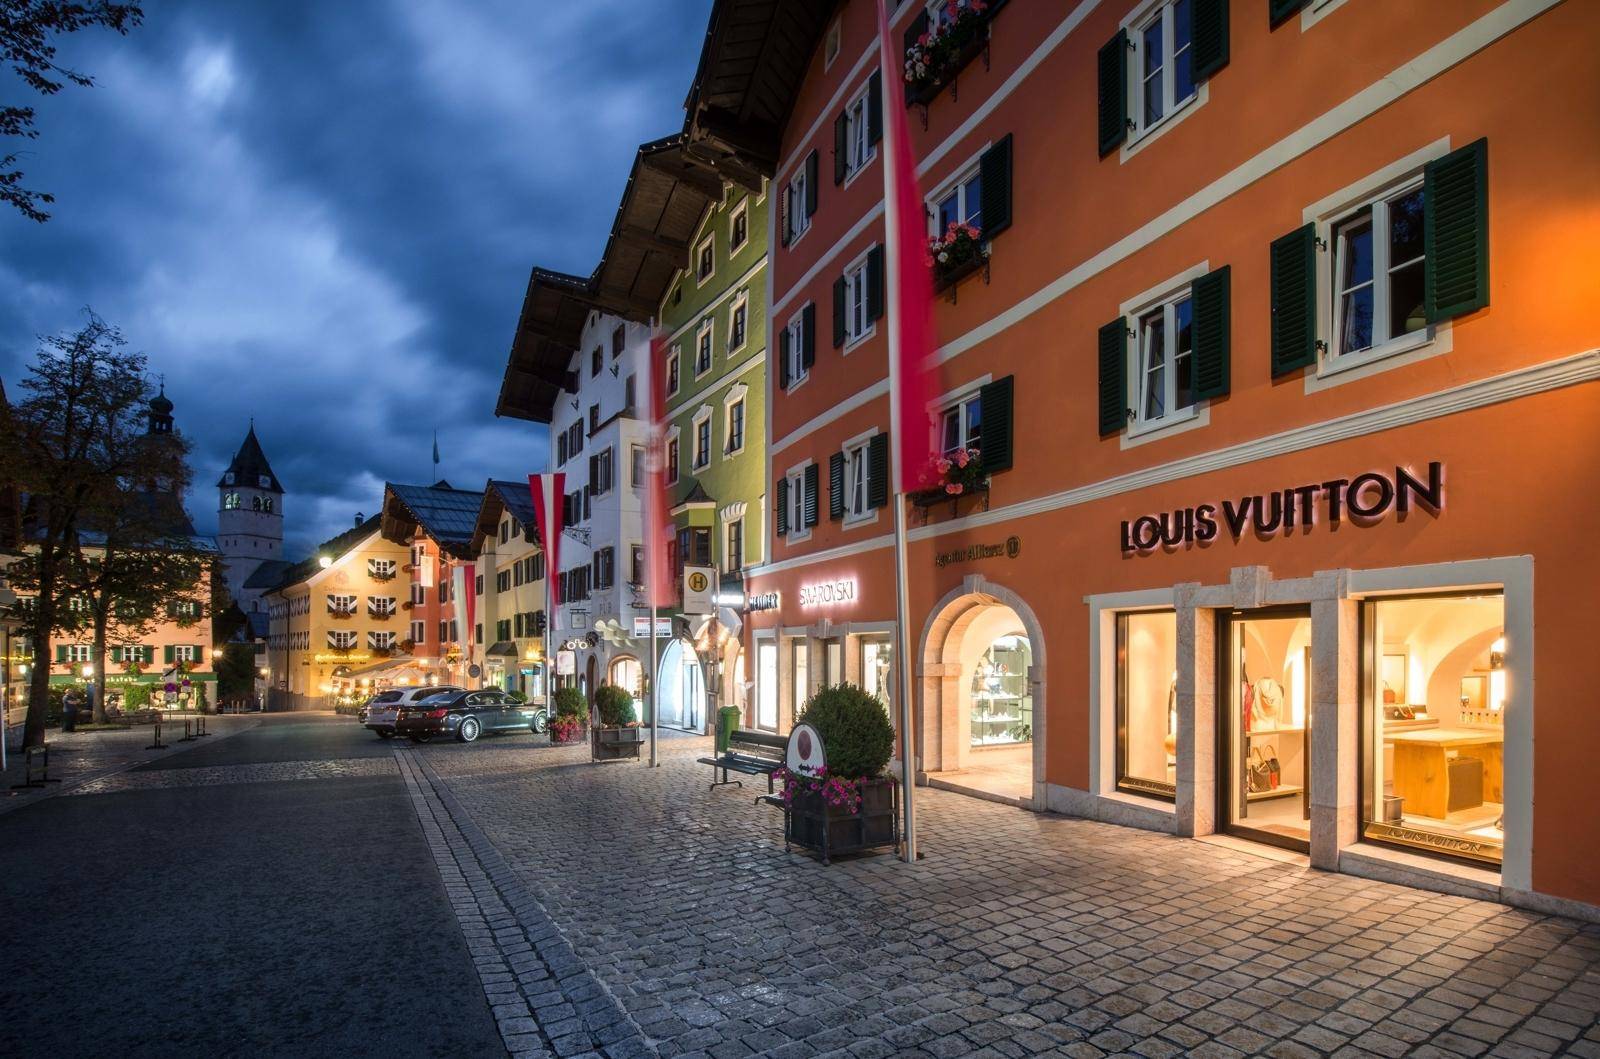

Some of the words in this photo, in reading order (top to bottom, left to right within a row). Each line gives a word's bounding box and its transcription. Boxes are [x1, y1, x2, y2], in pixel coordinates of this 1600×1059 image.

[1120, 504, 1217, 552] LOUIS
[1222, 461, 1441, 538] VUITTON
[800, 581, 854, 606] SWAROVSKI
[1386, 828, 1421, 841] LOUIS
[1425, 834, 1481, 854] VUITTON
